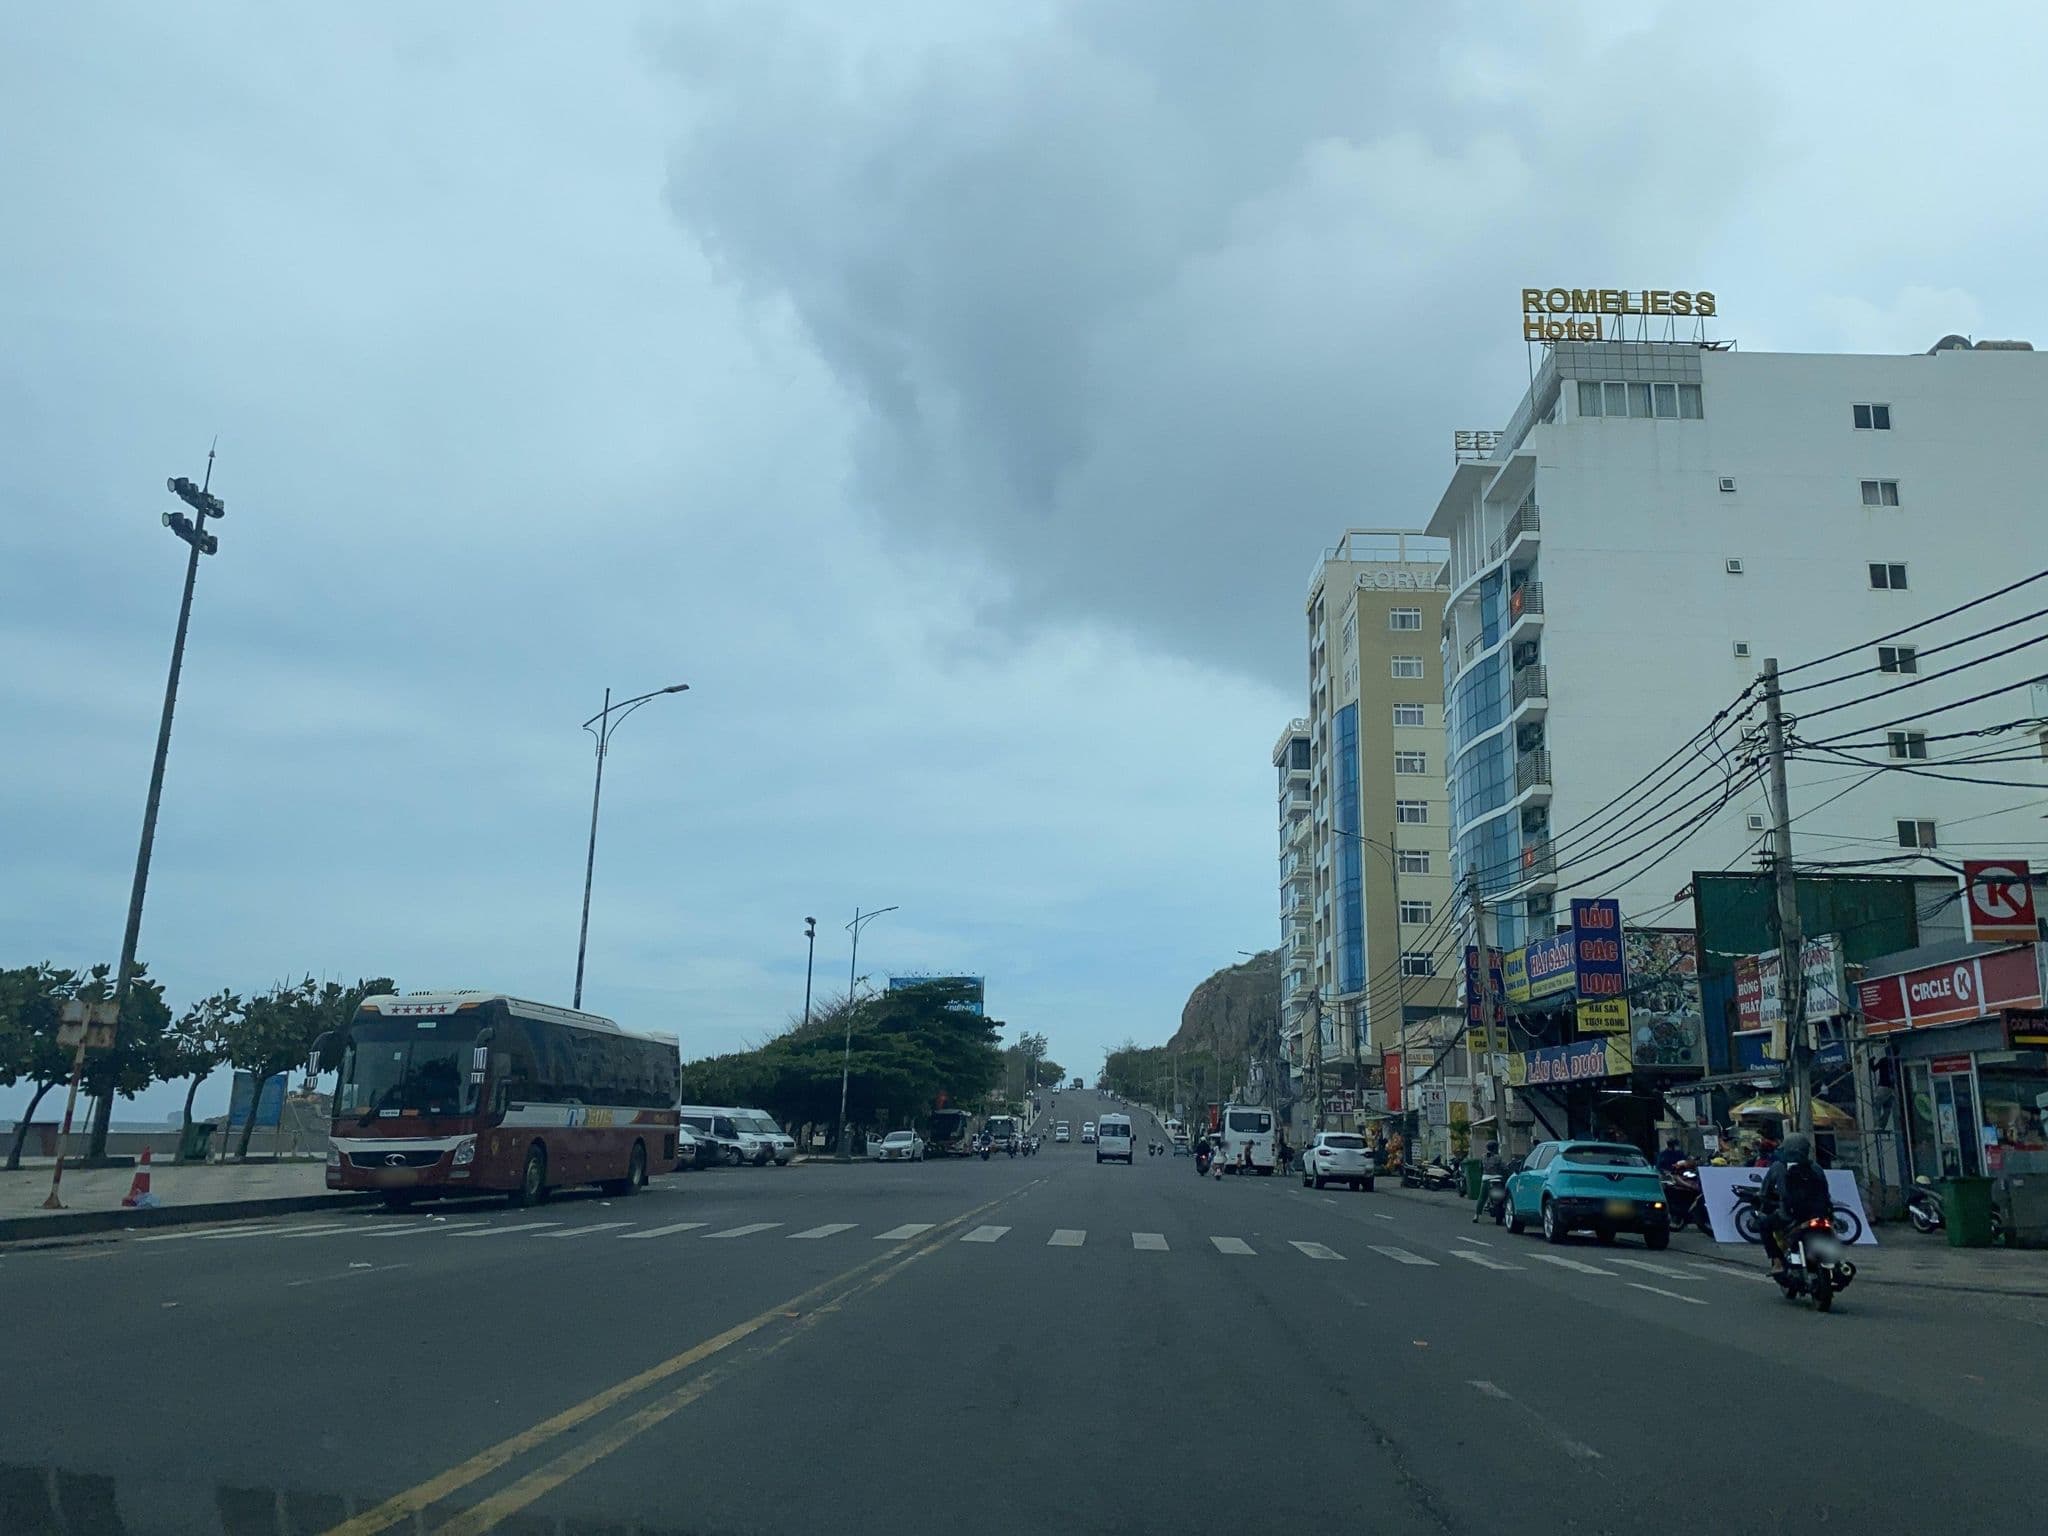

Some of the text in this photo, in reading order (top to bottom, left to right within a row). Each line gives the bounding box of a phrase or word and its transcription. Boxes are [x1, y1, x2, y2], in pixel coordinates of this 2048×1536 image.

[1522, 288, 1717, 316] ROMELIESS
[1523, 315, 1603, 341] Hotel
[1356, 570, 1438, 590] CORVI
[1580, 937, 1618, 961] CÁC
[1911, 978, 1952, 1002] CIRCLE
